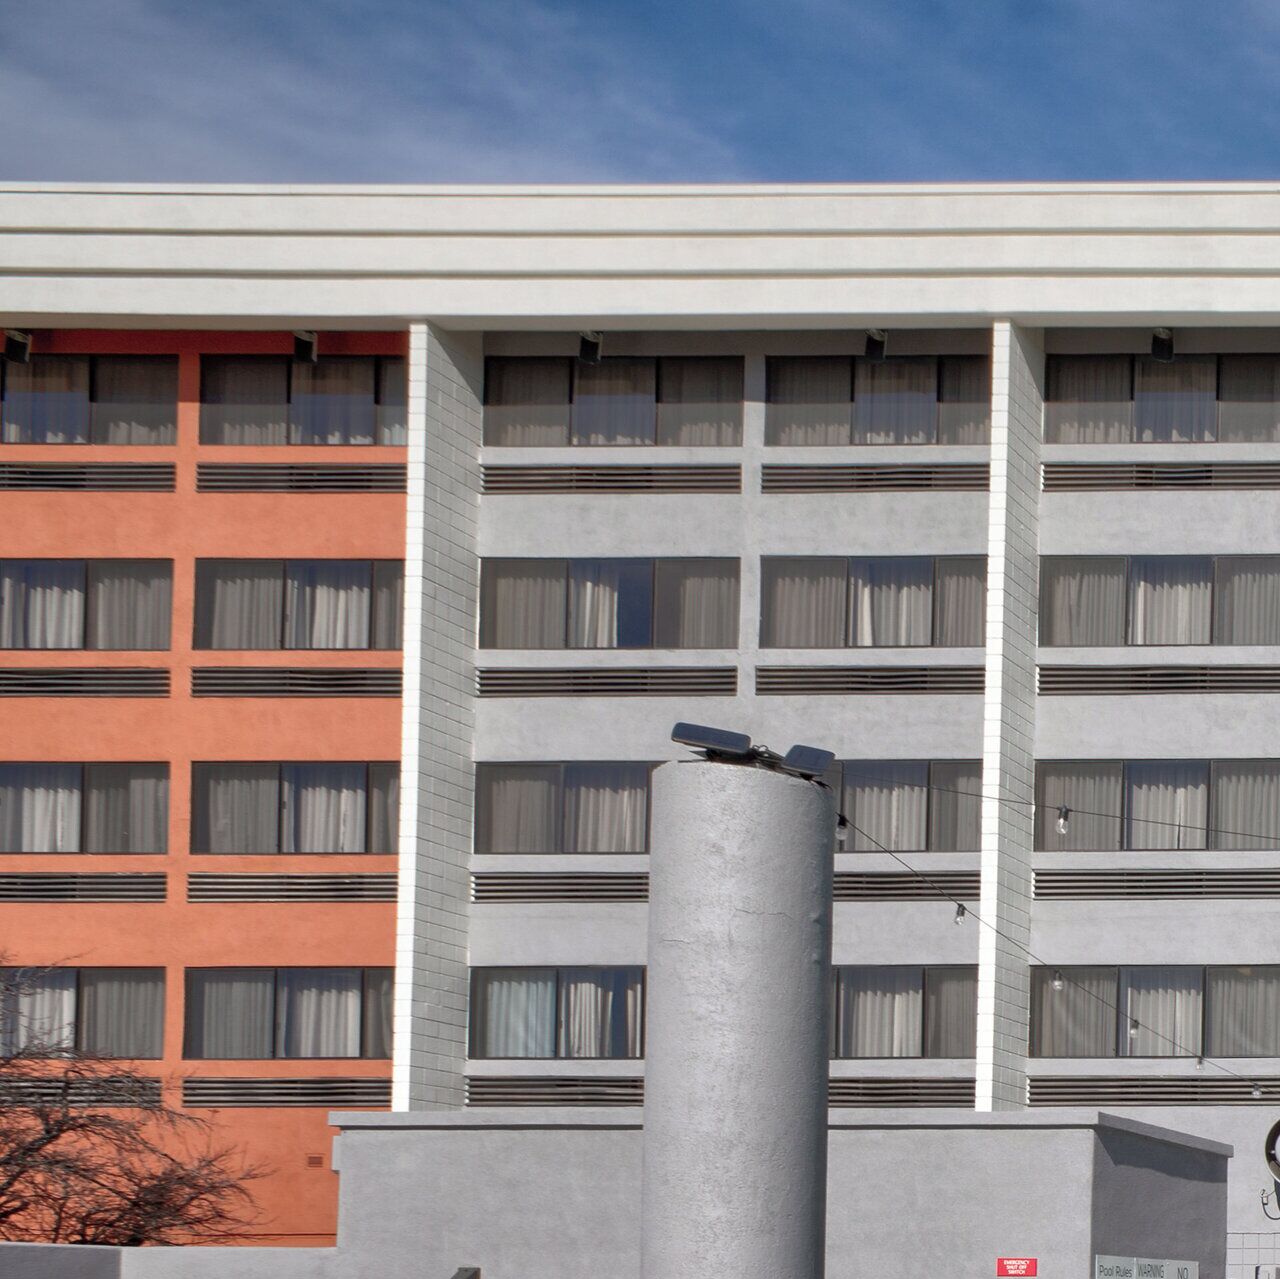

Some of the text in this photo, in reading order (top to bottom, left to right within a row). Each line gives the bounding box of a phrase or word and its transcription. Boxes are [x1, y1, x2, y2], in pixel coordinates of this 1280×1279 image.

[1099, 1264, 1132, 1278] Pool Rules
[1137, 1263, 1164, 1278] WARNING
